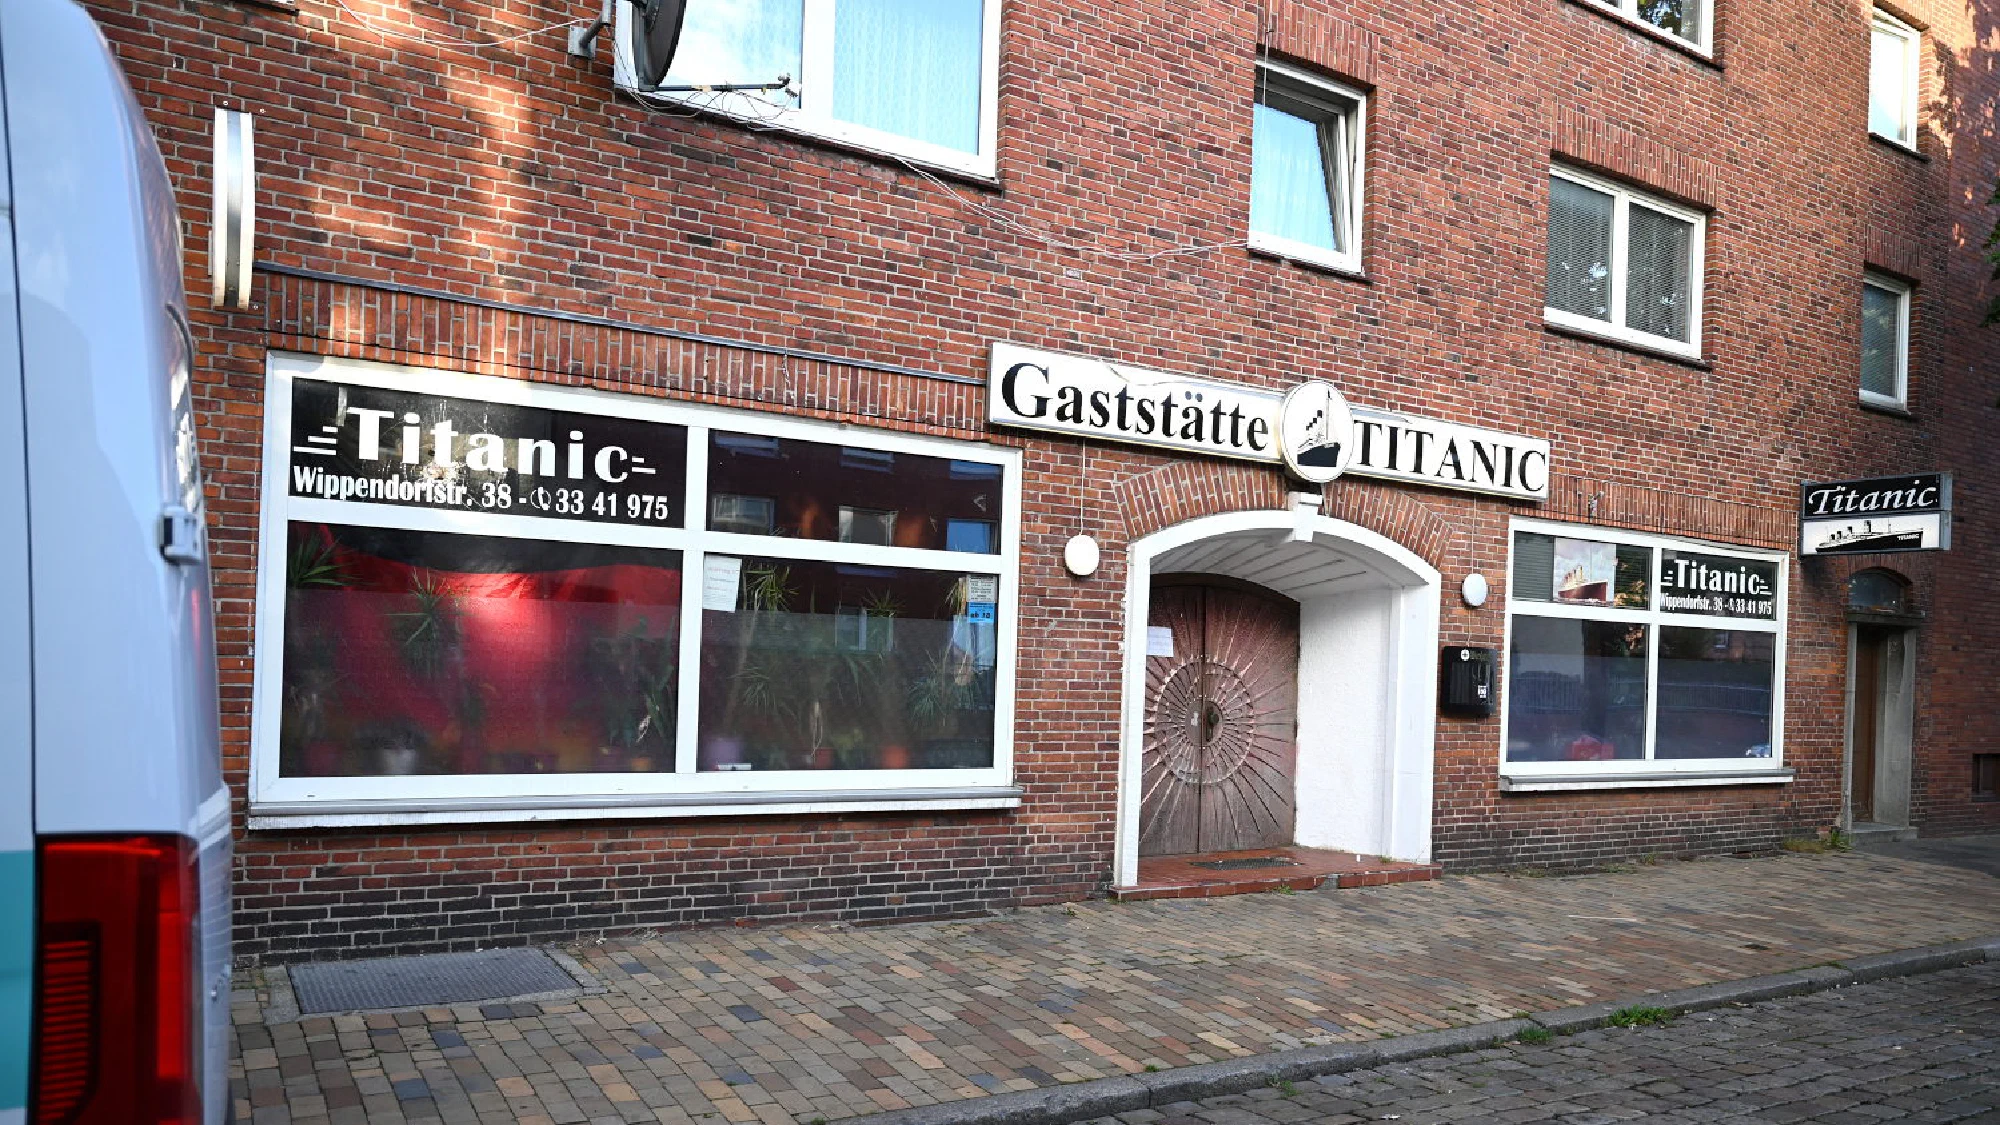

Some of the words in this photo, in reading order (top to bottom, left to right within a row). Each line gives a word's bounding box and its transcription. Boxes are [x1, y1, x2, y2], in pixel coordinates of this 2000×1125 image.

[347, 407, 629, 483] Titanic
[1001, 361, 1269, 450] Gaststätte
[1353, 418, 1546, 492] TITANIC
[294, 464, 472, 507] Wippendorfstr.
[481, 482, 512, 509] 38
[555, 487, 584, 515] 33
[591, 491, 617, 517] 41
[627, 494, 668, 521] 975
[1808, 479, 1937, 515] Titanic
[1674, 559, 1760, 594] Titanic
[1735, 597, 1746, 614] 33
[1758, 600, 1772, 615] 975
